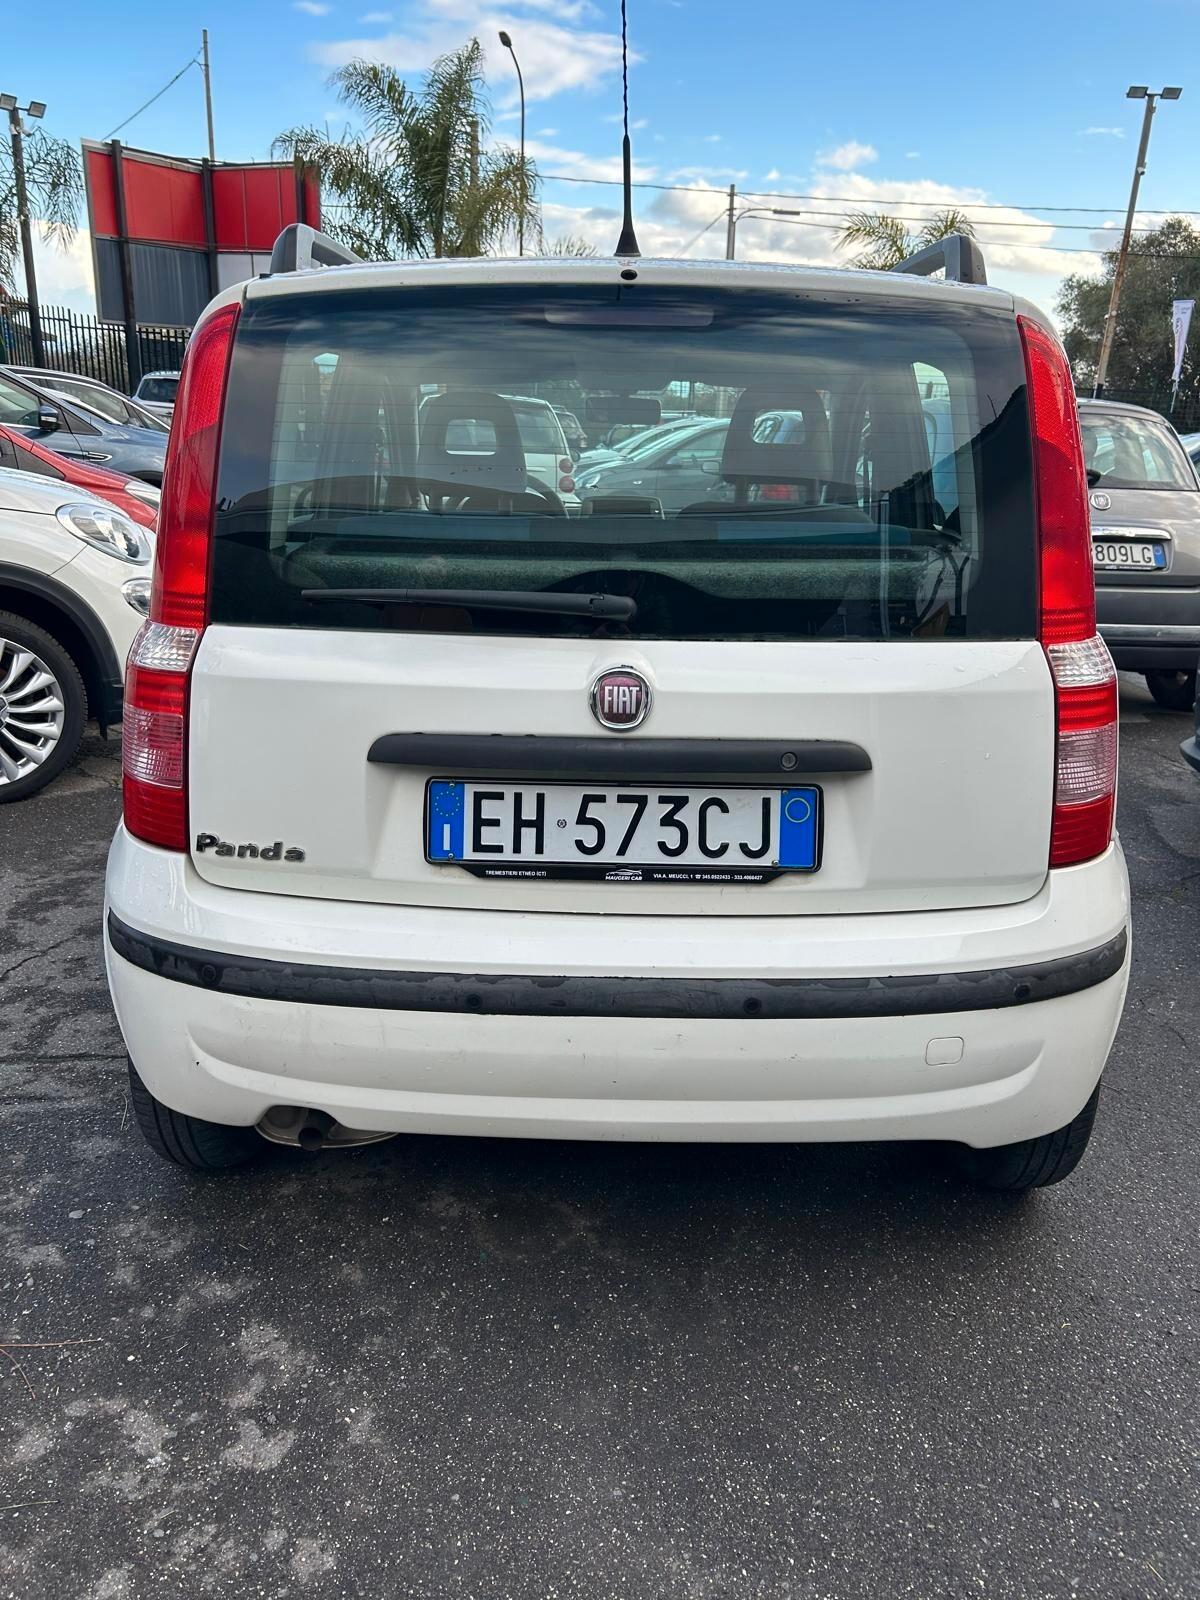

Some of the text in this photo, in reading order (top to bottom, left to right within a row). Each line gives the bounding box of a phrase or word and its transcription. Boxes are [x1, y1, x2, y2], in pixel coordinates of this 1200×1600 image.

[603, 686, 640, 715] FIAT
[472, 791, 772, 859] EH 573CJ
[196, 833, 305, 862] Panda
